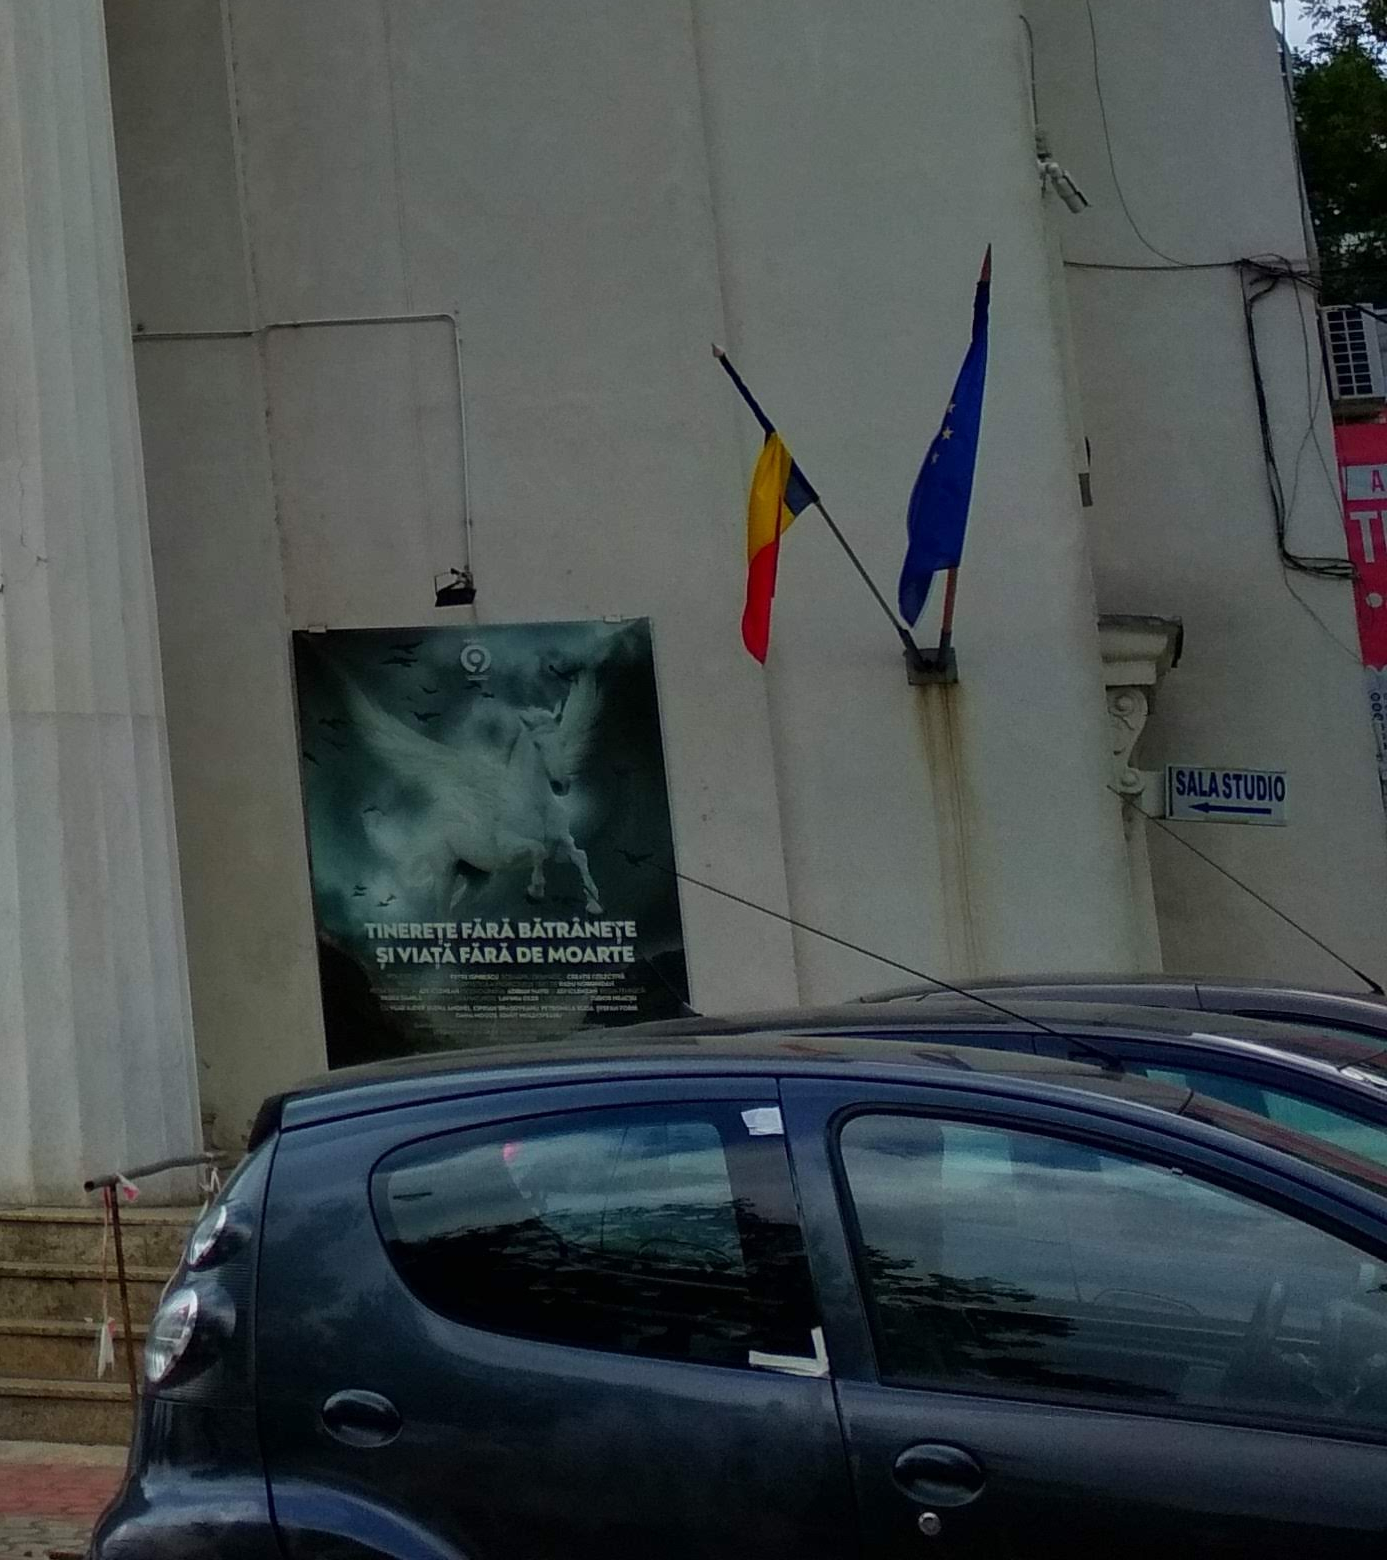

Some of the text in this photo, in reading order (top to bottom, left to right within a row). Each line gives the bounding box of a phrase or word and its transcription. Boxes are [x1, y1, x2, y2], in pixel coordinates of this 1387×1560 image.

[1176, 770, 1286, 802] SALA STUDIO
[363, 916, 638, 944] TINEREȚE FĂRĂ BĂTRÂNEȚE
[375, 942, 636, 969] ȘI VIAȚĂ FĂRĂ DE MOARTE
